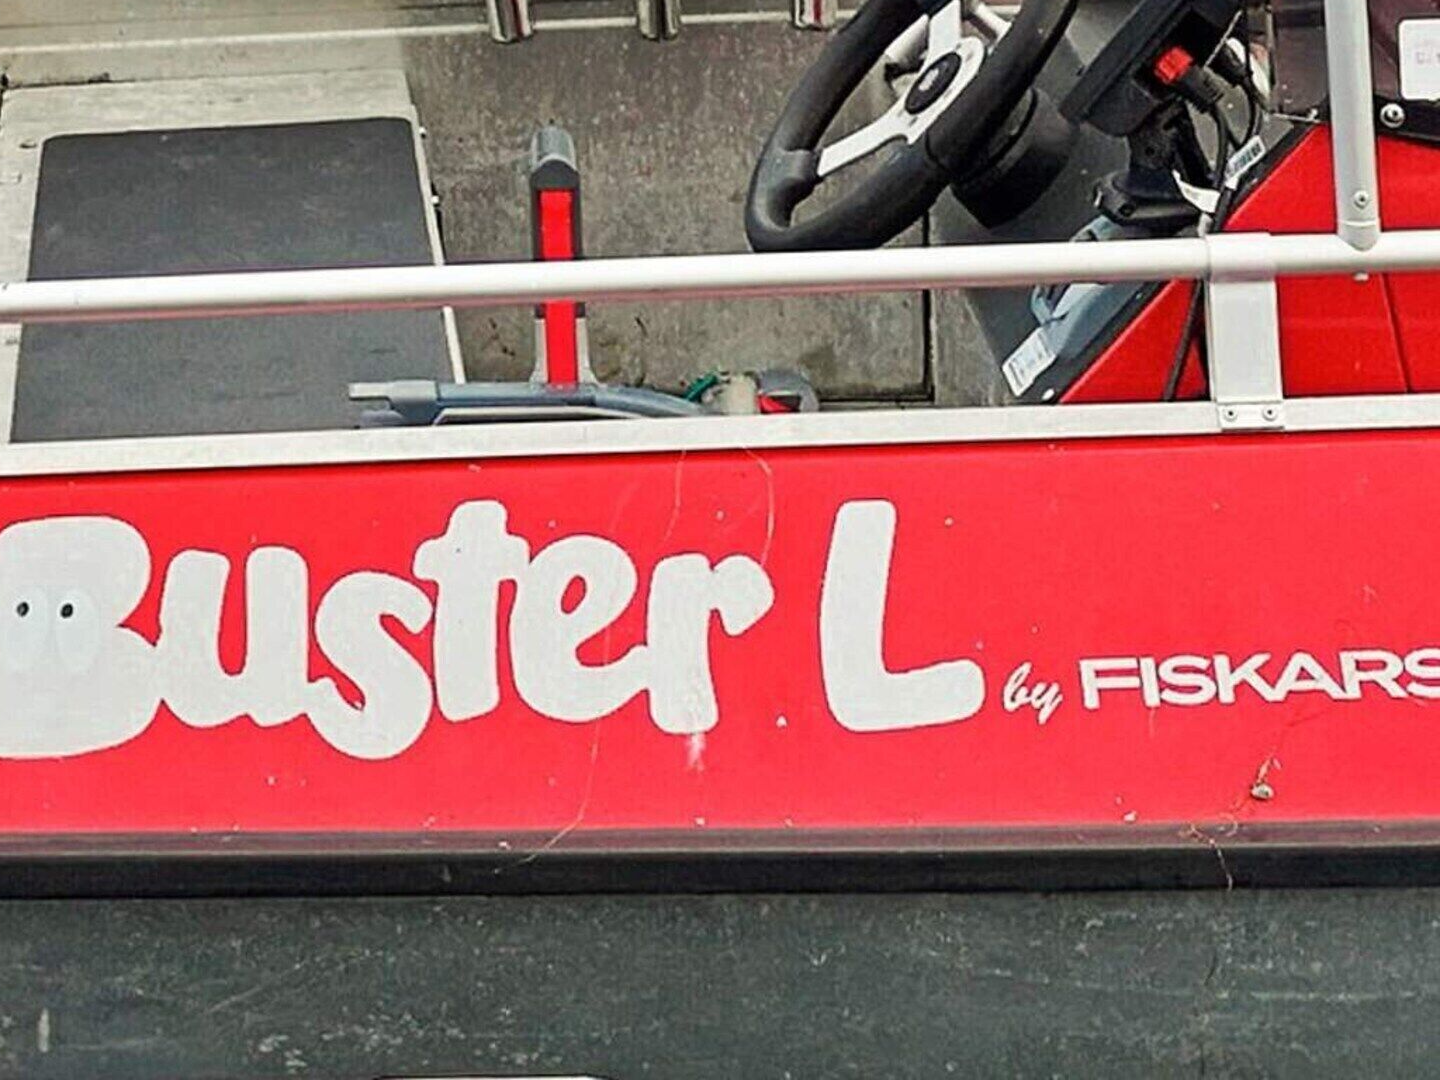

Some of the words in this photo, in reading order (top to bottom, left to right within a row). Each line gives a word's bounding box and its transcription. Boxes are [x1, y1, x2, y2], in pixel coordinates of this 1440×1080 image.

[819, 498, 986, 732] L
[1002, 660, 1063, 725] by
[1078, 647, 1440, 710] FISKARS
